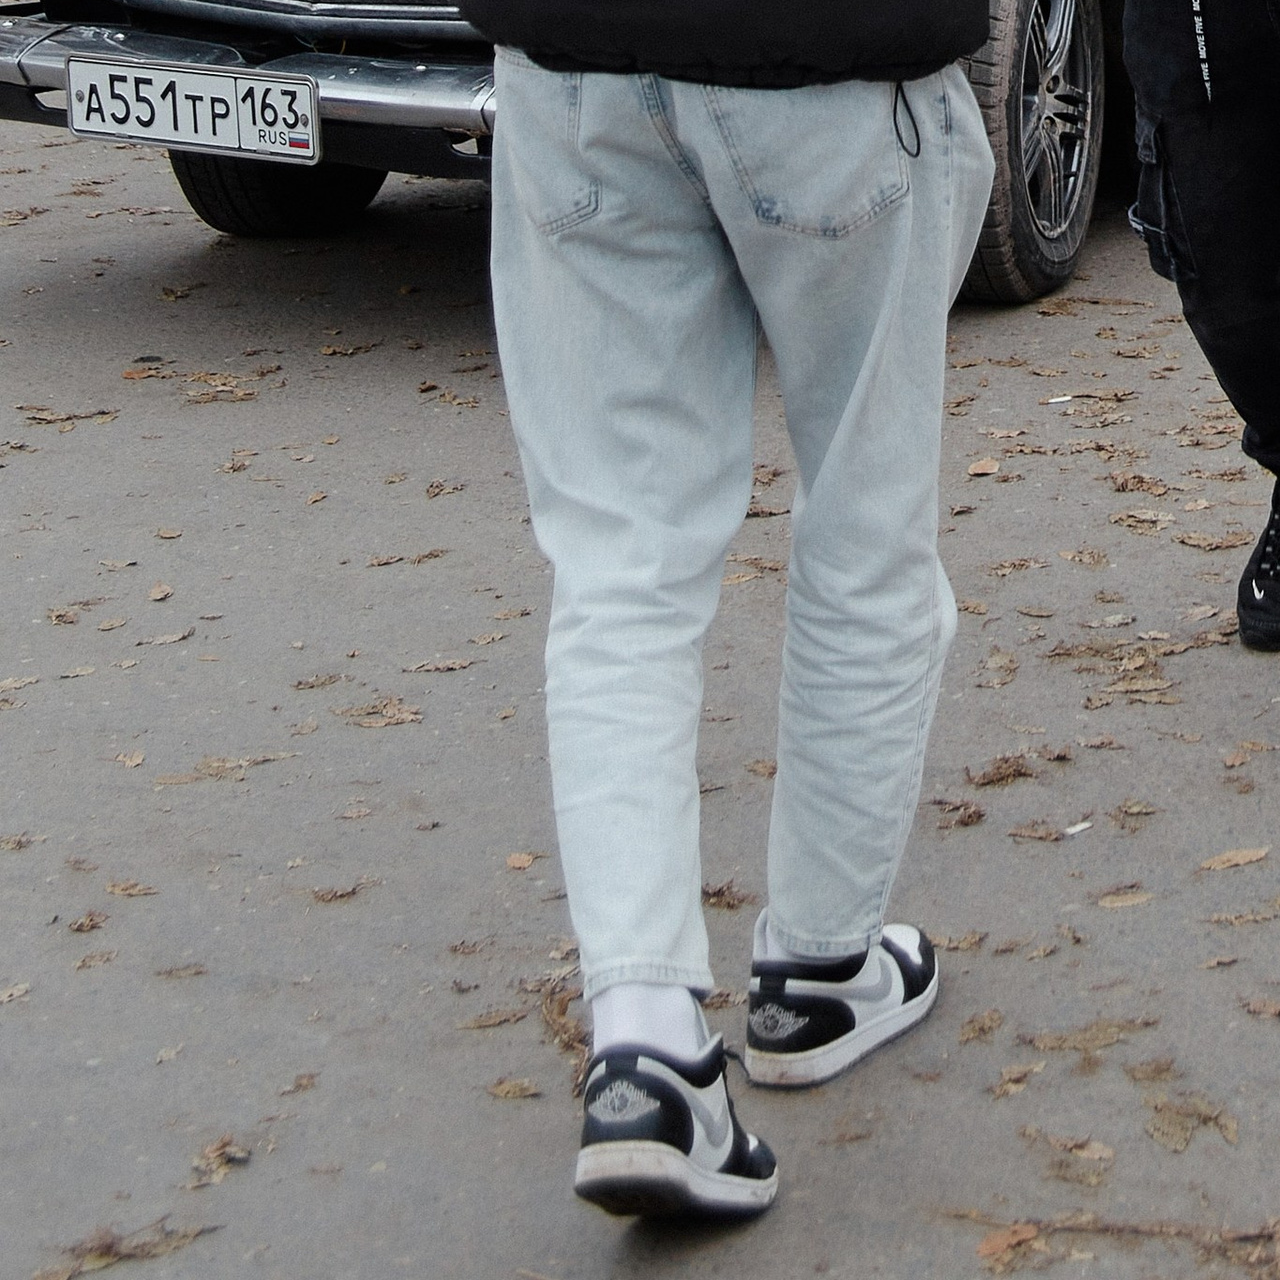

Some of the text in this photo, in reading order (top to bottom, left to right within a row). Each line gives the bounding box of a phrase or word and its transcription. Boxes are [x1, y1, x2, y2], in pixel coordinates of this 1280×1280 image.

[1194, 15, 1203, 34] FIVE
[1196, 34, 1206, 59] MOVE
[240, 86, 300, 129] 163
[258, 129, 287, 147] RUS
